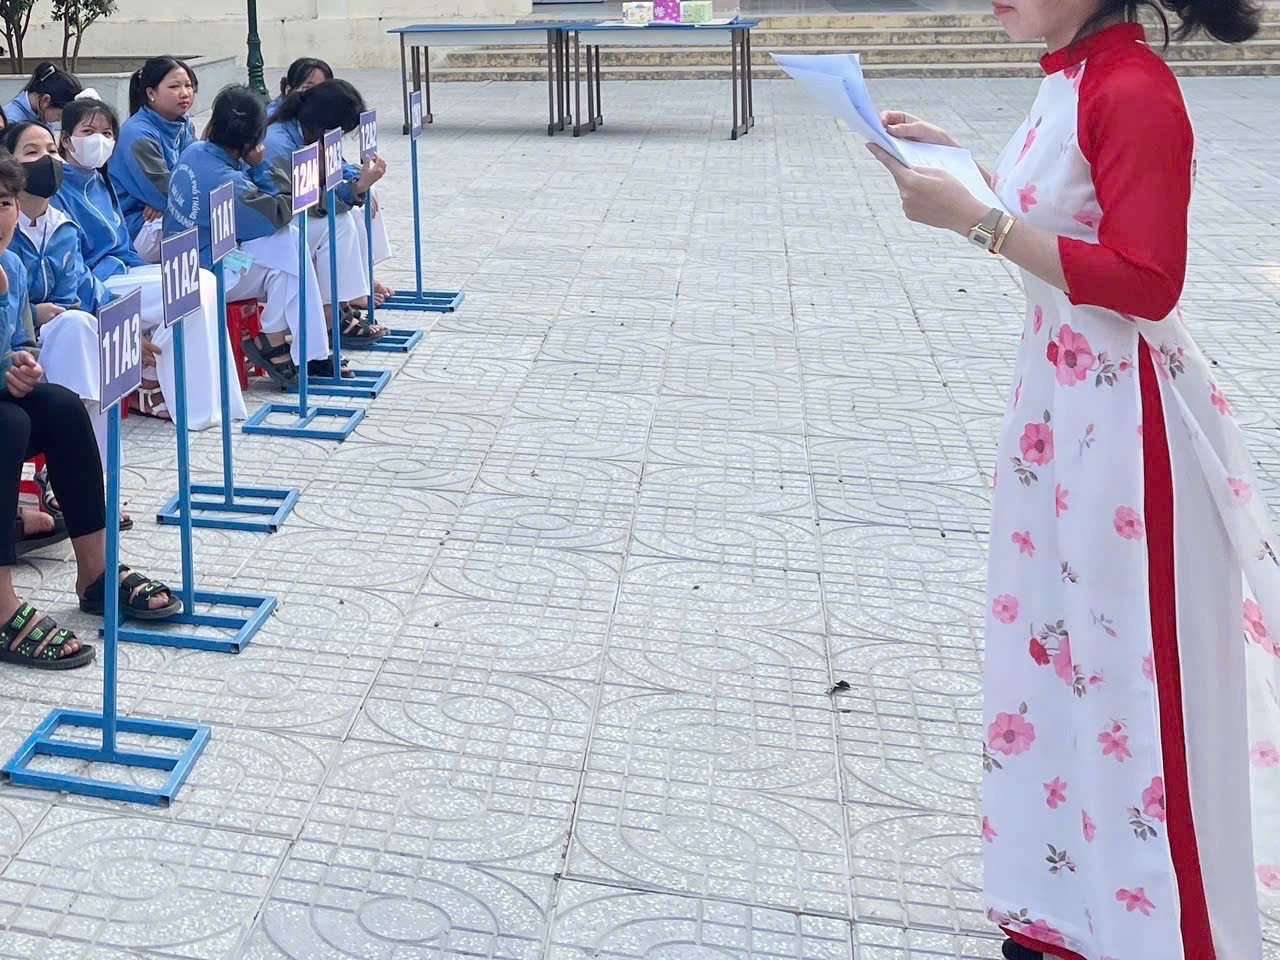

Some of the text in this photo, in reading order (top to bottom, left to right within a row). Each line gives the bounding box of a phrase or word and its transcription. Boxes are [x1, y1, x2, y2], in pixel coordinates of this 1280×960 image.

[211, 198, 234, 245] 11A1
[163, 247, 199, 305] 11A2
[102, 312, 140, 385] 11A3
